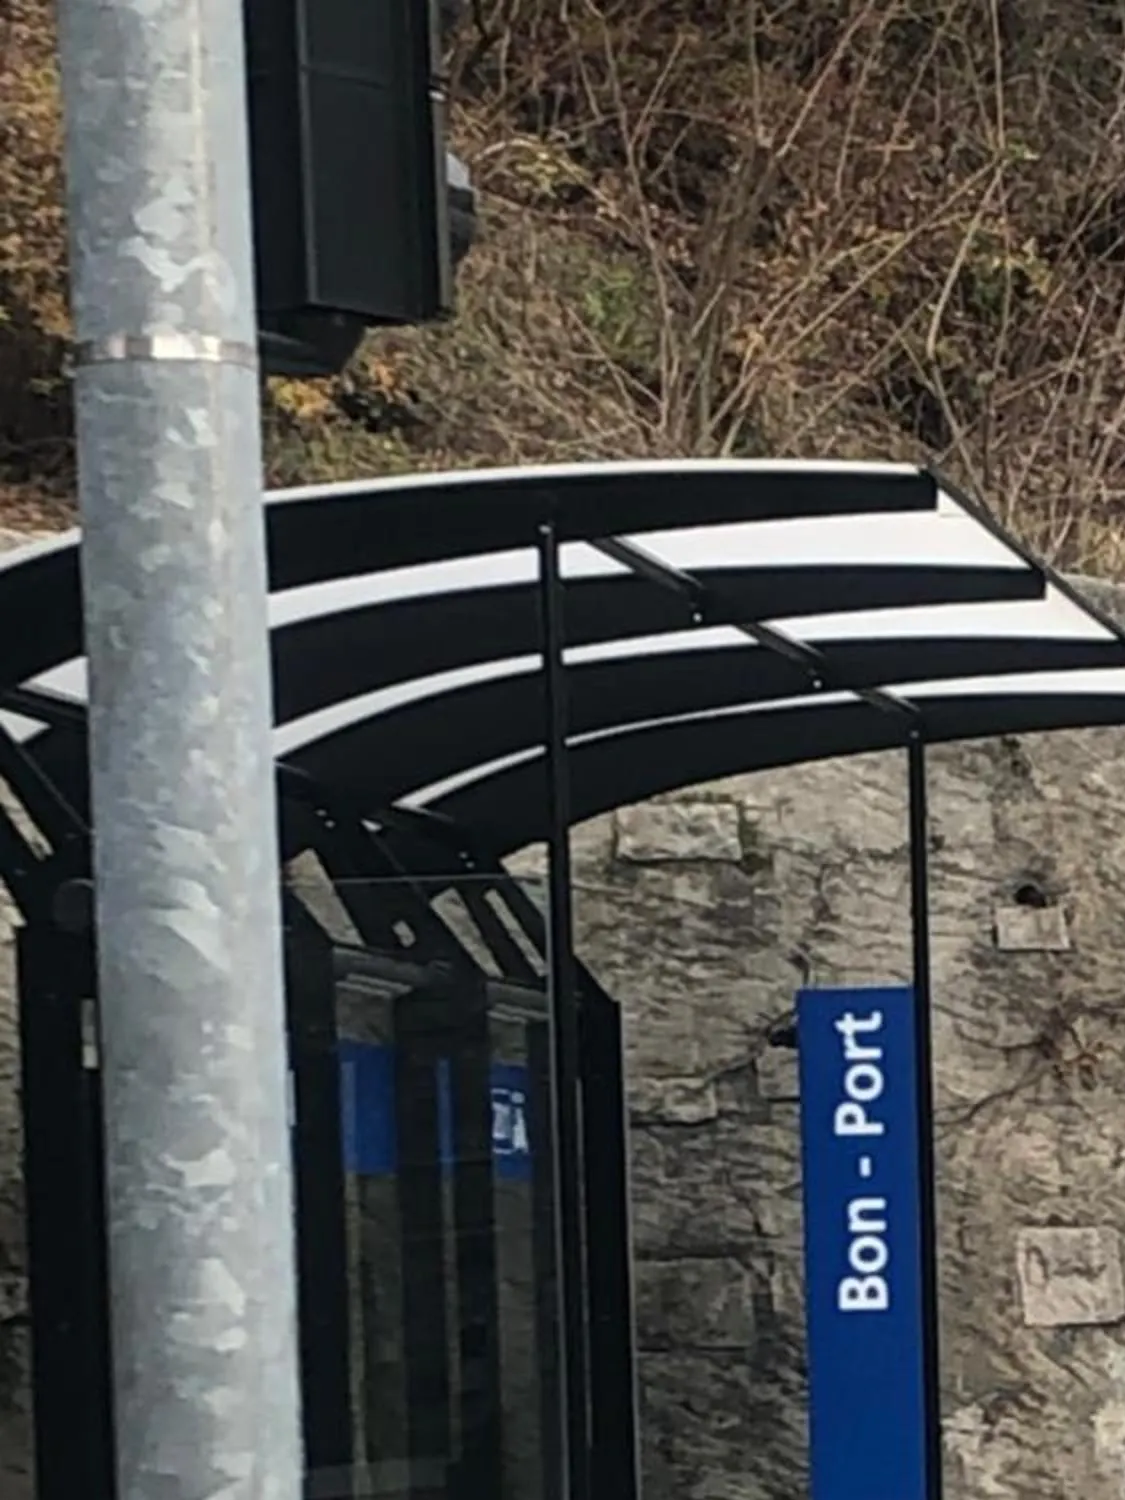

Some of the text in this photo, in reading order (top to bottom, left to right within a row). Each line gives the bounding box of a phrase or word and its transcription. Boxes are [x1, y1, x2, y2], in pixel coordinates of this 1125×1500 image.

[834, 1010, 889, 1311] Bon - Port
